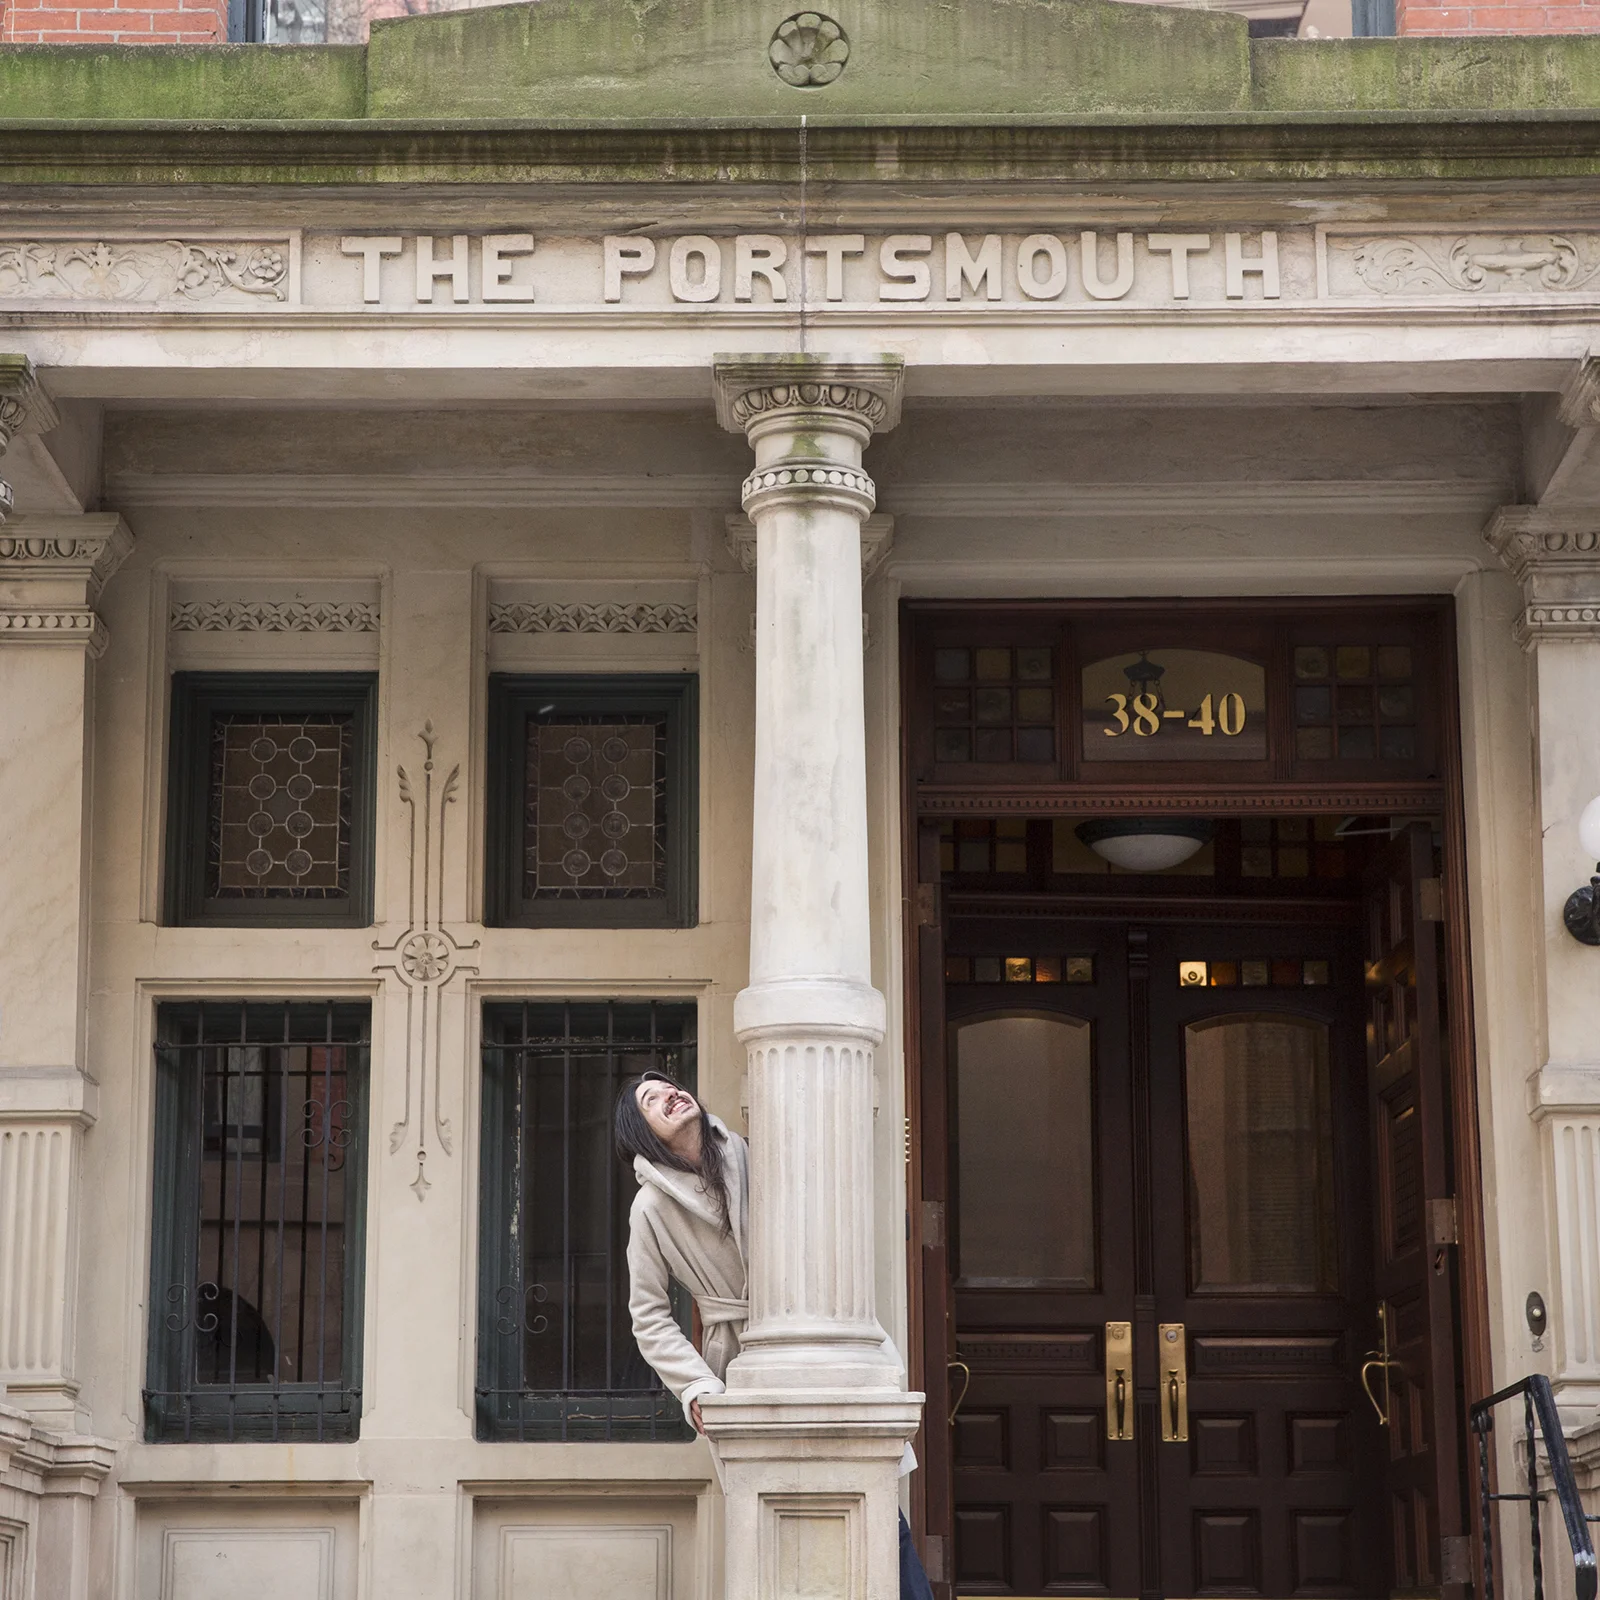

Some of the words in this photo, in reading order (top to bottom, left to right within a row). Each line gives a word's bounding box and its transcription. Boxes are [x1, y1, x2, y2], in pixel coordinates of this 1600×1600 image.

[341, 234, 535, 303] THE
[603, 230, 1281, 303] PORTSMOUTH
[1103, 692, 1246, 737] 38-40
